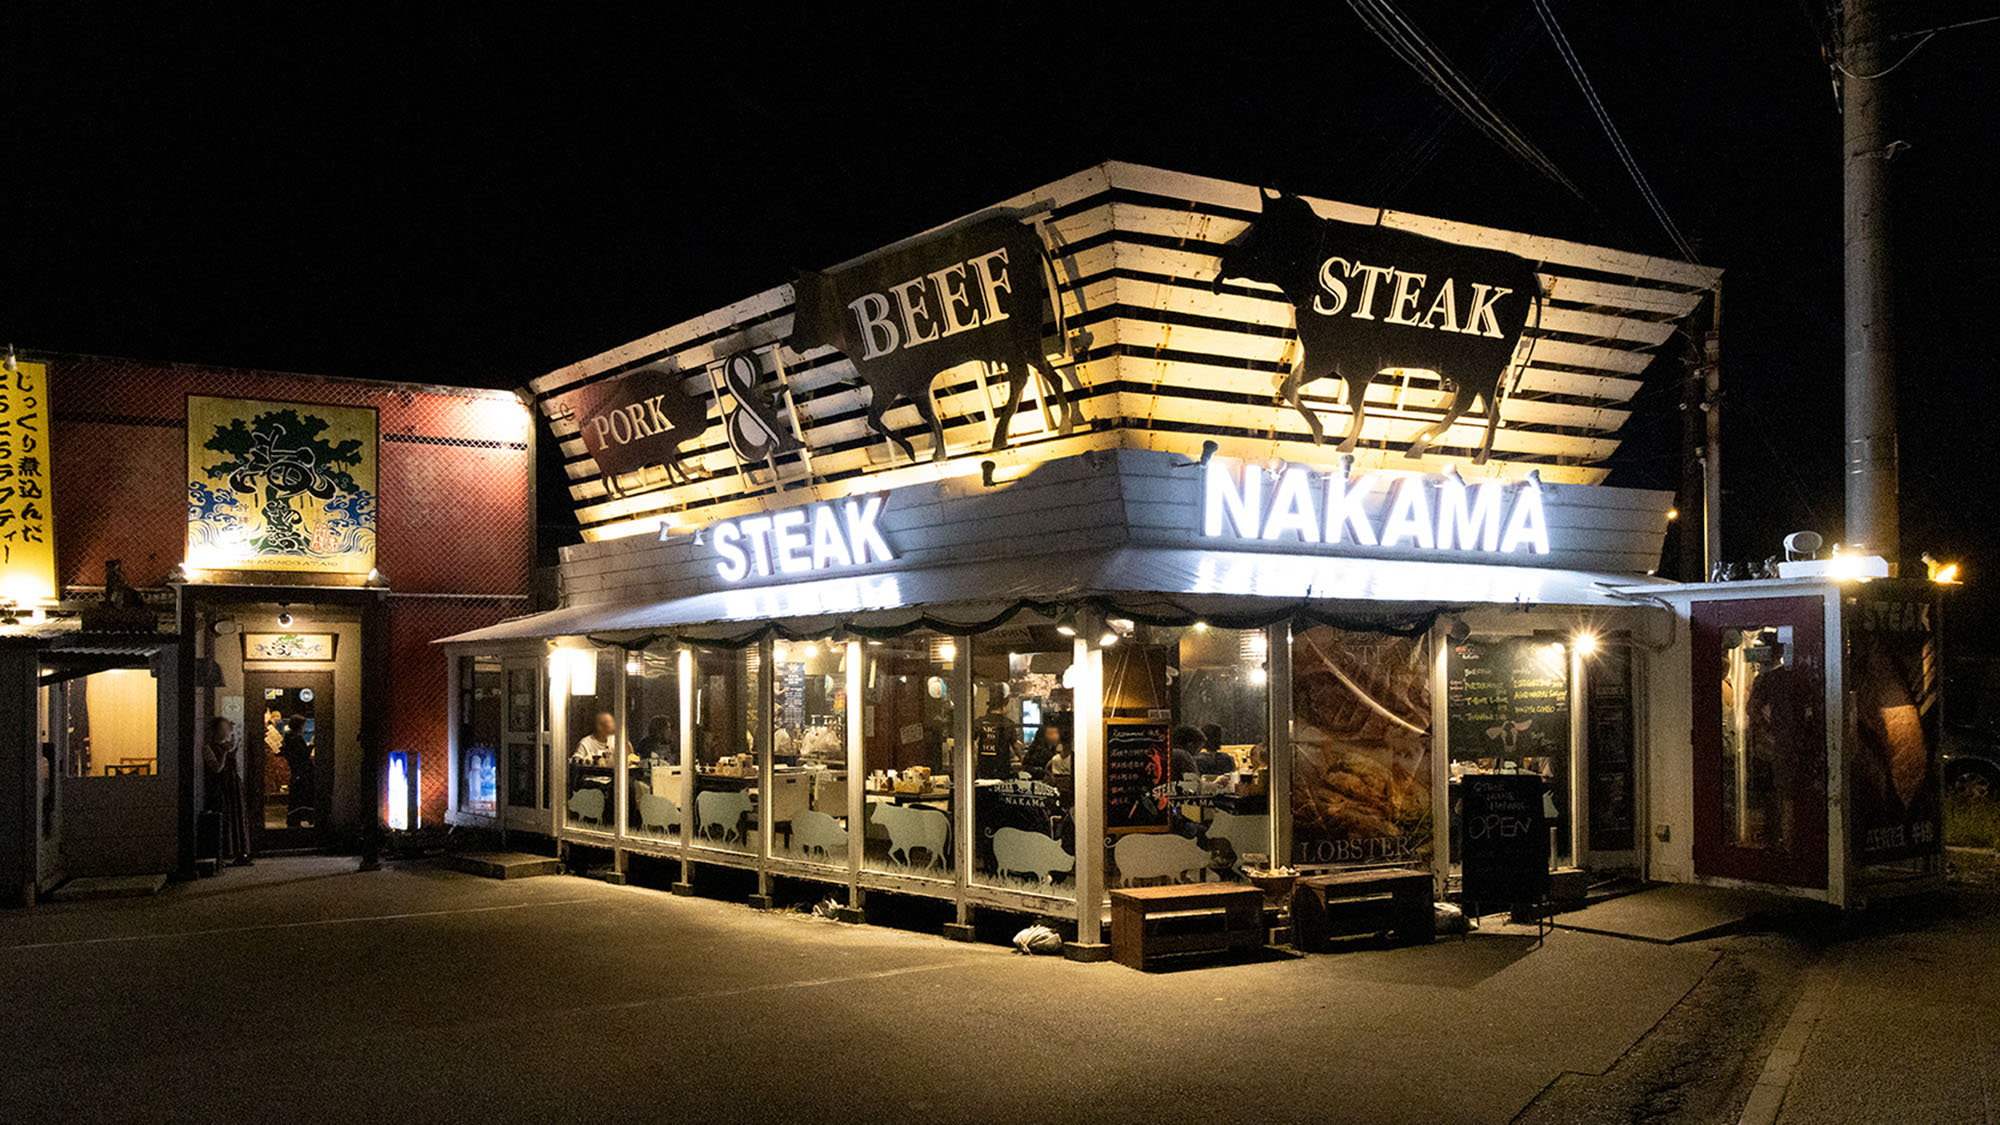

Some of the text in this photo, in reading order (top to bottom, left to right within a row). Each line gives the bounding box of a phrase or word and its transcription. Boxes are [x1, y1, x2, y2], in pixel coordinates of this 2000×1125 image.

[847, 247, 1013, 361] BEEF
[1313, 256, 1514, 339] STEAK
[591, 394, 676, 451] PORK
[722, 349, 800, 464] &
[15, 371, 44, 544] じっくり煮込んだ
[712, 496, 895, 583] STEAK
[1203, 461, 1551, 555] NAKAMA
[1005, 796, 1046, 807] NAKAMA
[1468, 814, 1533, 840] OPEN
[1300, 836, 1413, 862] LOBSTER
